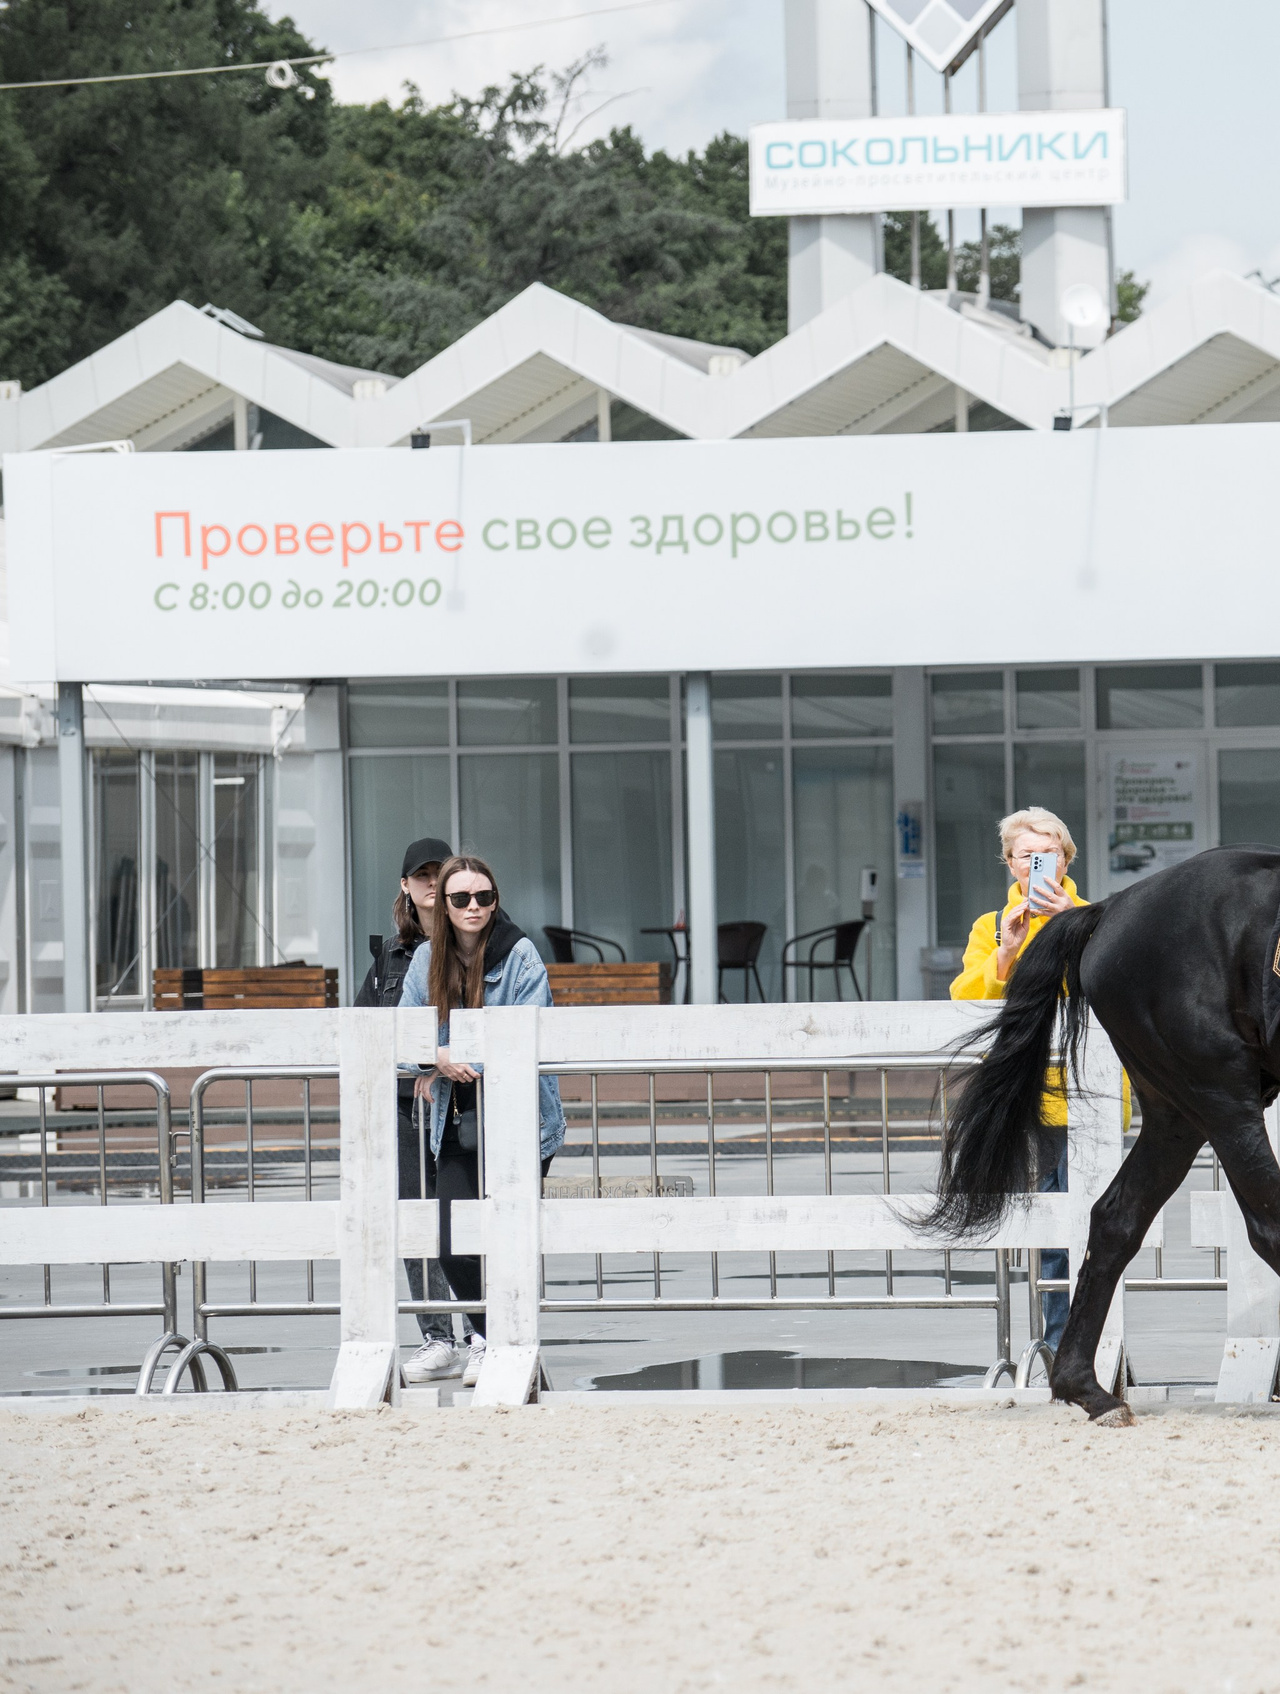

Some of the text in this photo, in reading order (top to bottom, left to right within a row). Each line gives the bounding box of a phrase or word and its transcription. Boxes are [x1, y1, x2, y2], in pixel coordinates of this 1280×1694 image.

[764, 131, 1109, 170] СОКОЛЬНИКИ
[1050, 167, 1111, 182] центр
[153, 491, 915, 570] Проверьте свое здоровье!
[188, 581, 273, 611] 8:00
[281, 578, 324, 609] до
[332, 577, 443, 609] 20:00
